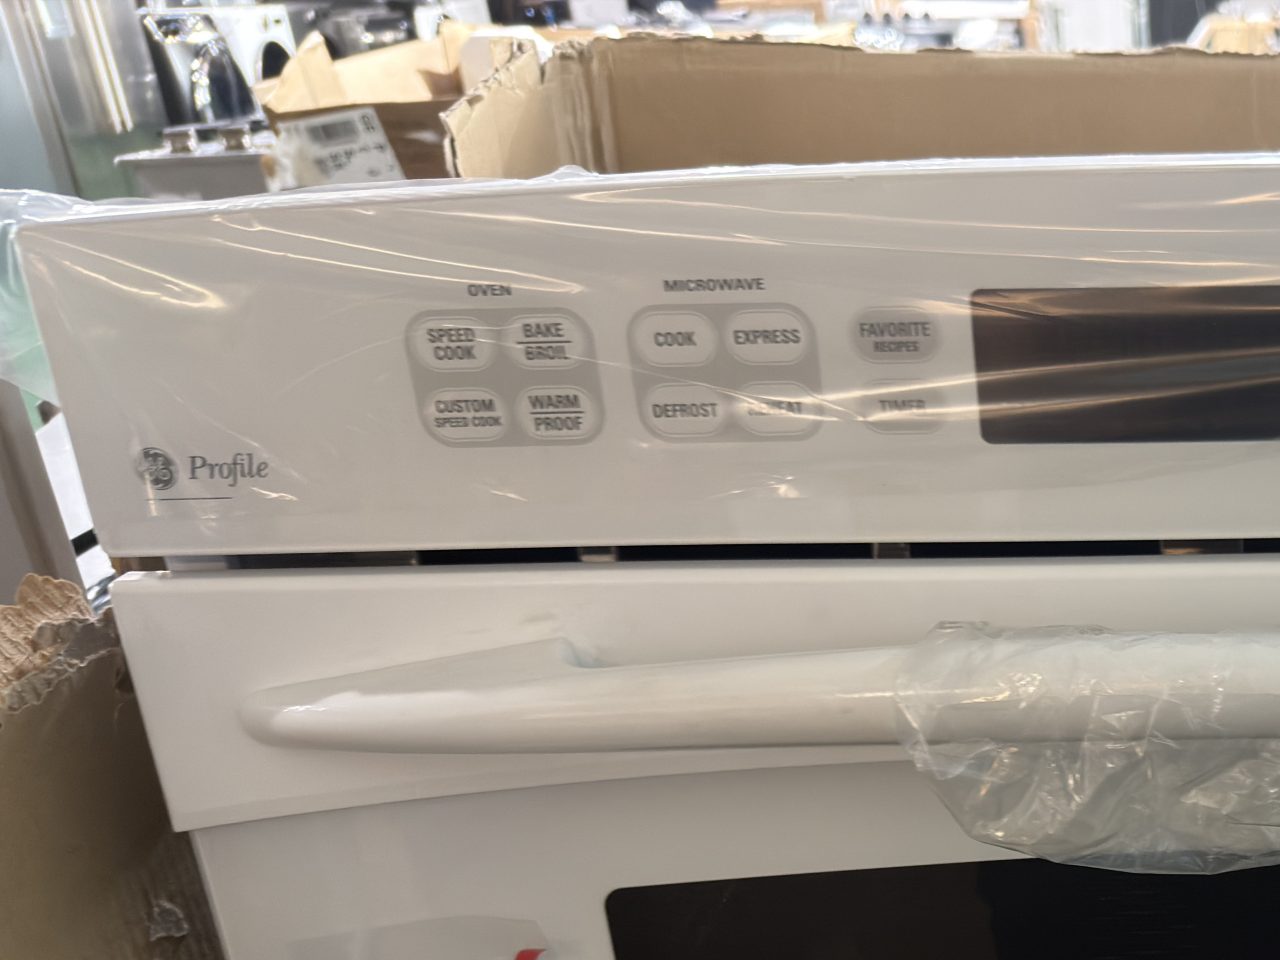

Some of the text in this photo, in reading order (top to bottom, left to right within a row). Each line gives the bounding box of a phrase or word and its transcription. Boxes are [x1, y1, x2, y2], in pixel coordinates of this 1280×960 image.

[467, 284, 512, 297] OVEN
[662, 278, 766, 292] MICROWAVE
[426, 328, 477, 343] SPEED
[522, 323, 565, 338] BAKE
[733, 329, 801, 345] EXPRESS
[859, 322, 931, 338] FAVORITE
[654, 331, 697, 347] COOK
[433, 346, 477, 360] COOK
[525, 346, 571, 360] BROIL
[873, 341, 919, 352] RECIPES
[434, 399, 496, 413] CUSTOM
[528, 395, 581, 409] WARM
[652, 403, 718, 418] DEFROST
[434, 416, 503, 428] SPEED COOK
[533, 416, 583, 431] PROOF
[188, 453, 269, 487] Profile
